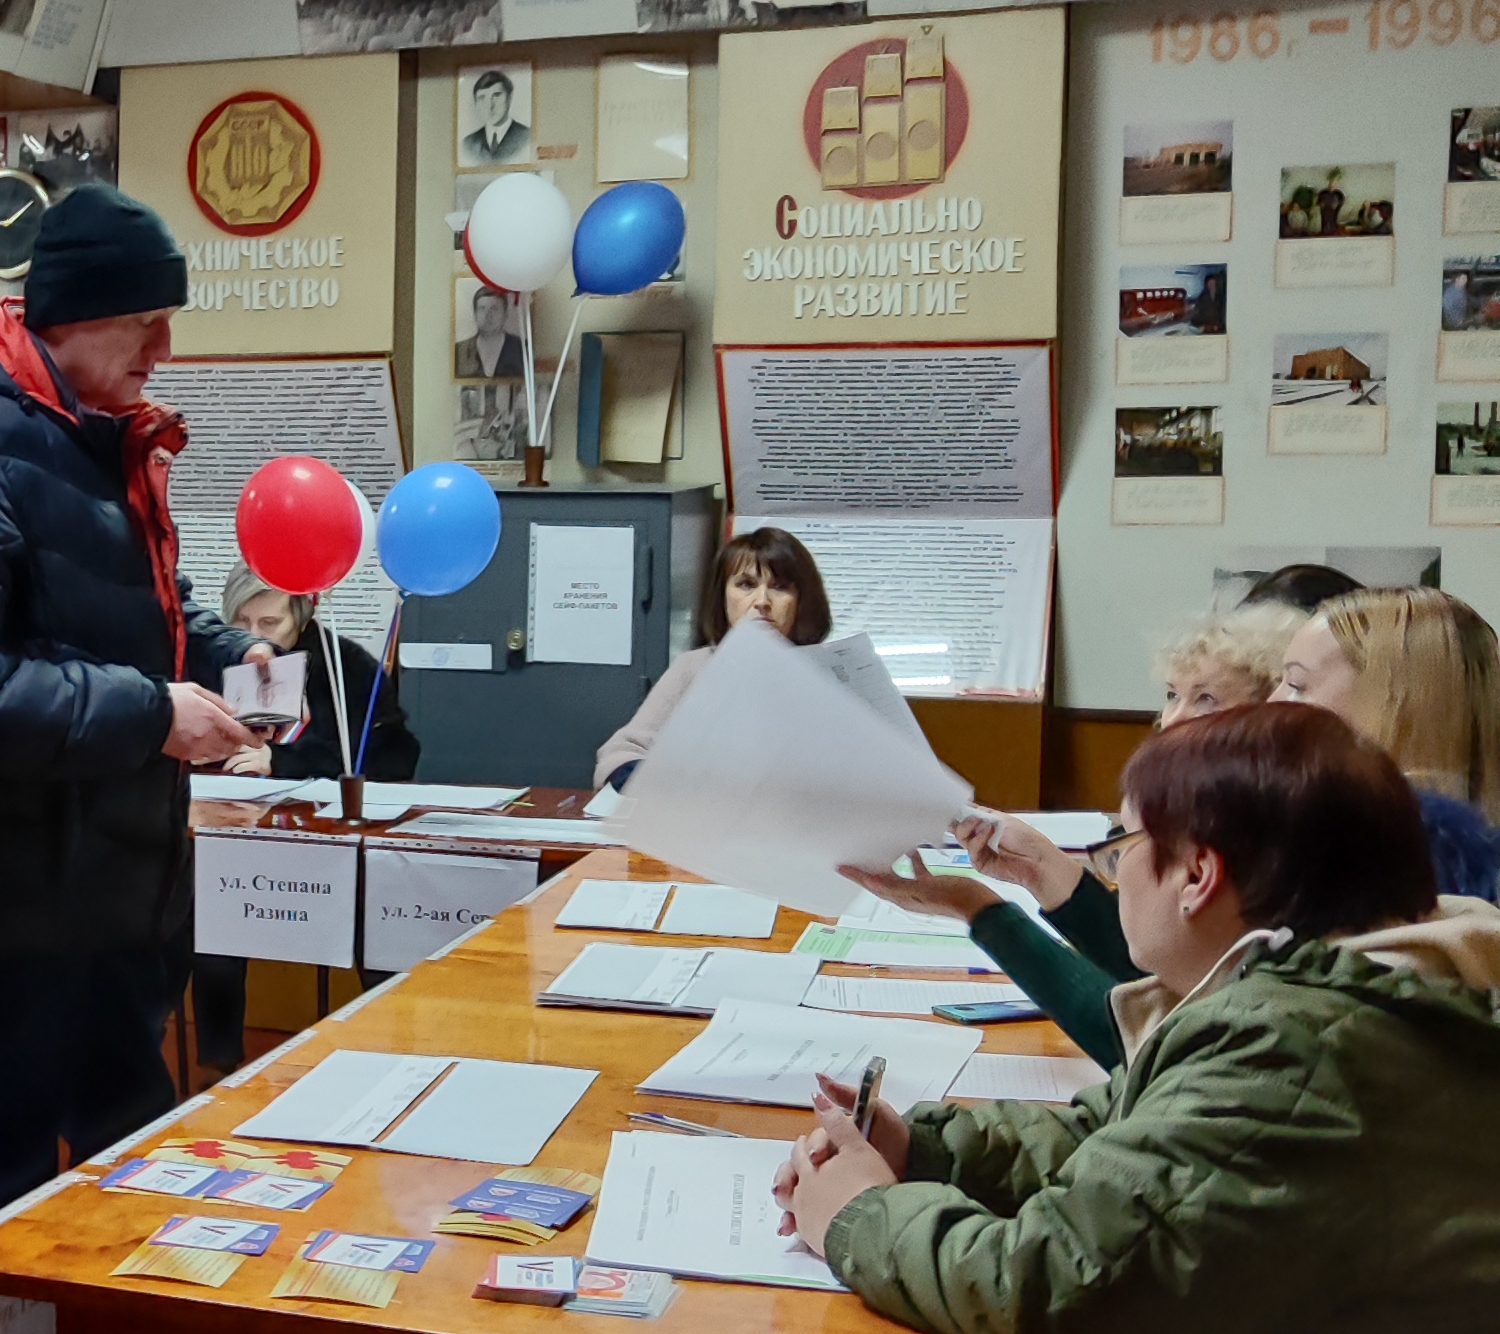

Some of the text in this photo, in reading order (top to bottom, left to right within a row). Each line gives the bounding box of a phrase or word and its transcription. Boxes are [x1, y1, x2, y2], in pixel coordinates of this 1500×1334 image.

[776, 195, 984, 240] СОЦИАЛЬНО
[179, 236, 345, 272] ХНИЧЕСКОЕ
[743, 237, 1026, 282] ЭКОНОМИЧЕСКОЕ
[181, 278, 340, 311] ВОРЧЕСТВО
[794, 278, 969, 319] РАЗВИТИЕ
[219, 874, 331, 895] ул. Степана
[243, 902, 309, 922] Разина
[381, 906, 408, 921] ул.
[413, 904, 450, 922] 2-ая
